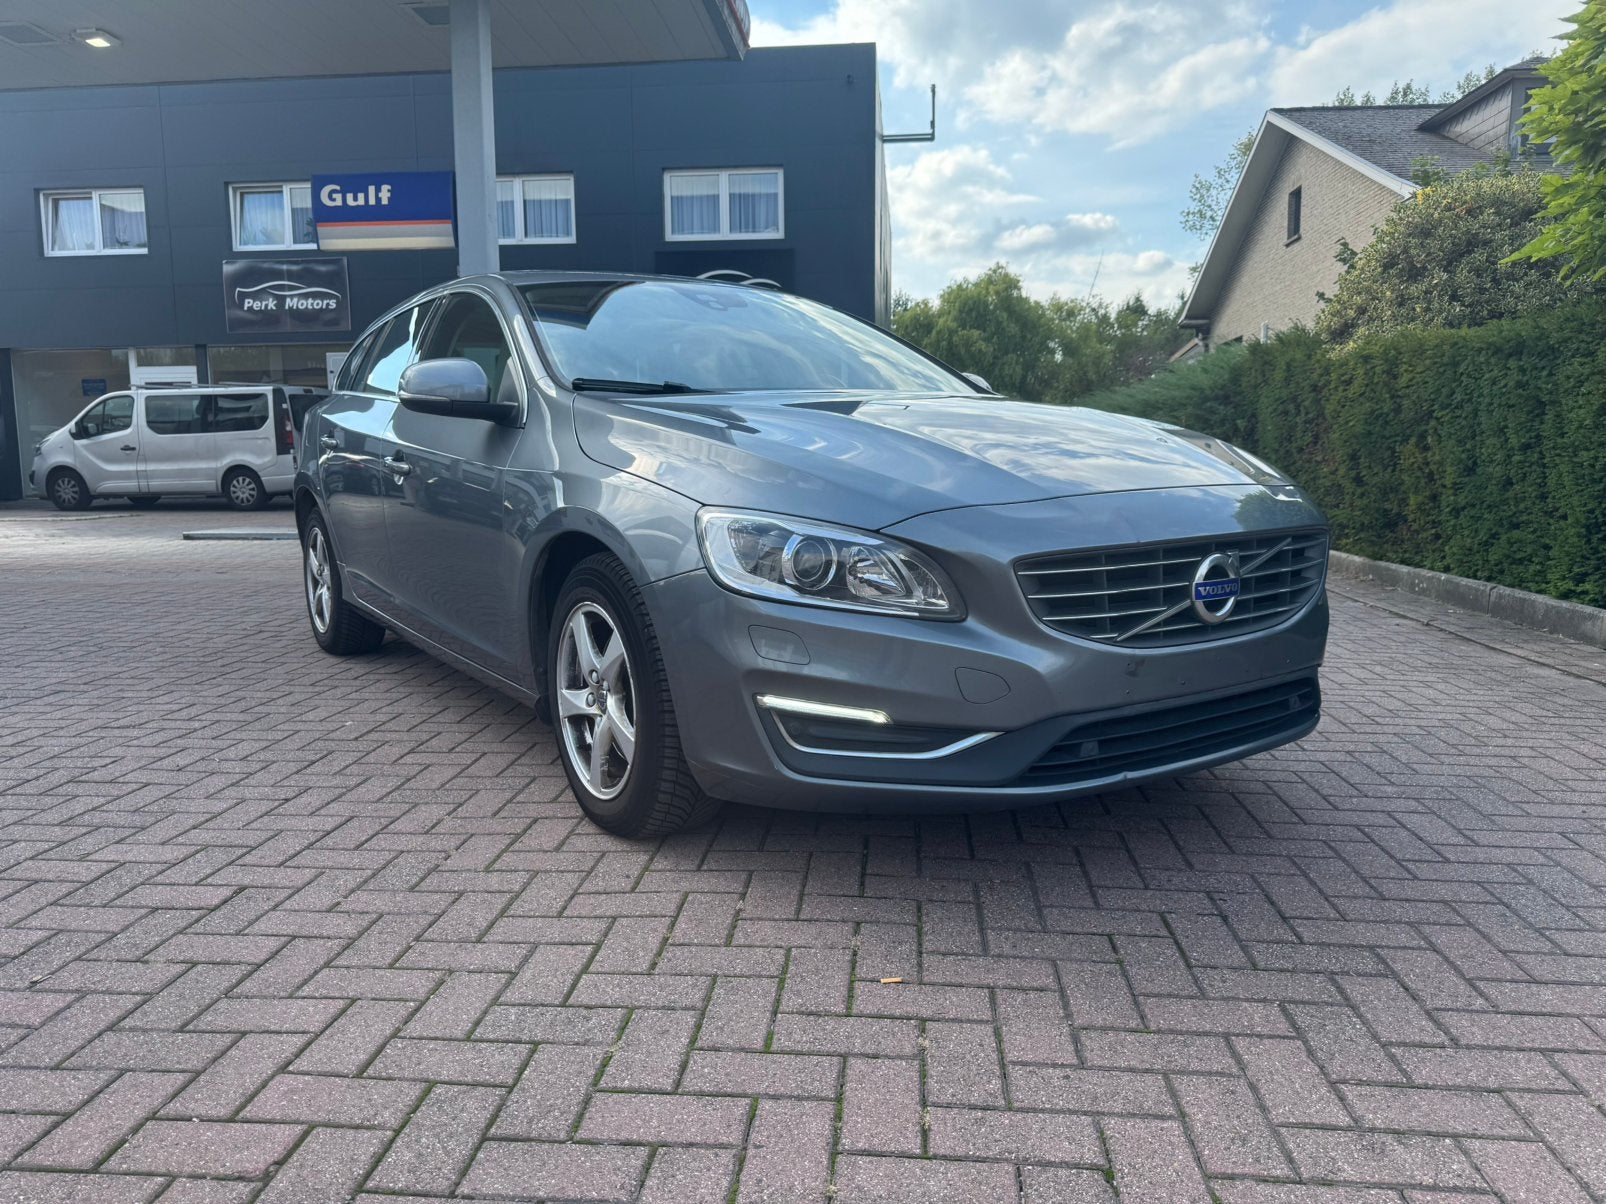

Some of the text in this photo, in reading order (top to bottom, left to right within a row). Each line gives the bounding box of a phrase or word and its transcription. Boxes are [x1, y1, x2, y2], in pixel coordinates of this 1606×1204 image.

[320, 184, 392, 207] Gulf
[243, 297, 337, 311] Perk Motors
[1197, 582, 1238, 596] VOLVO
